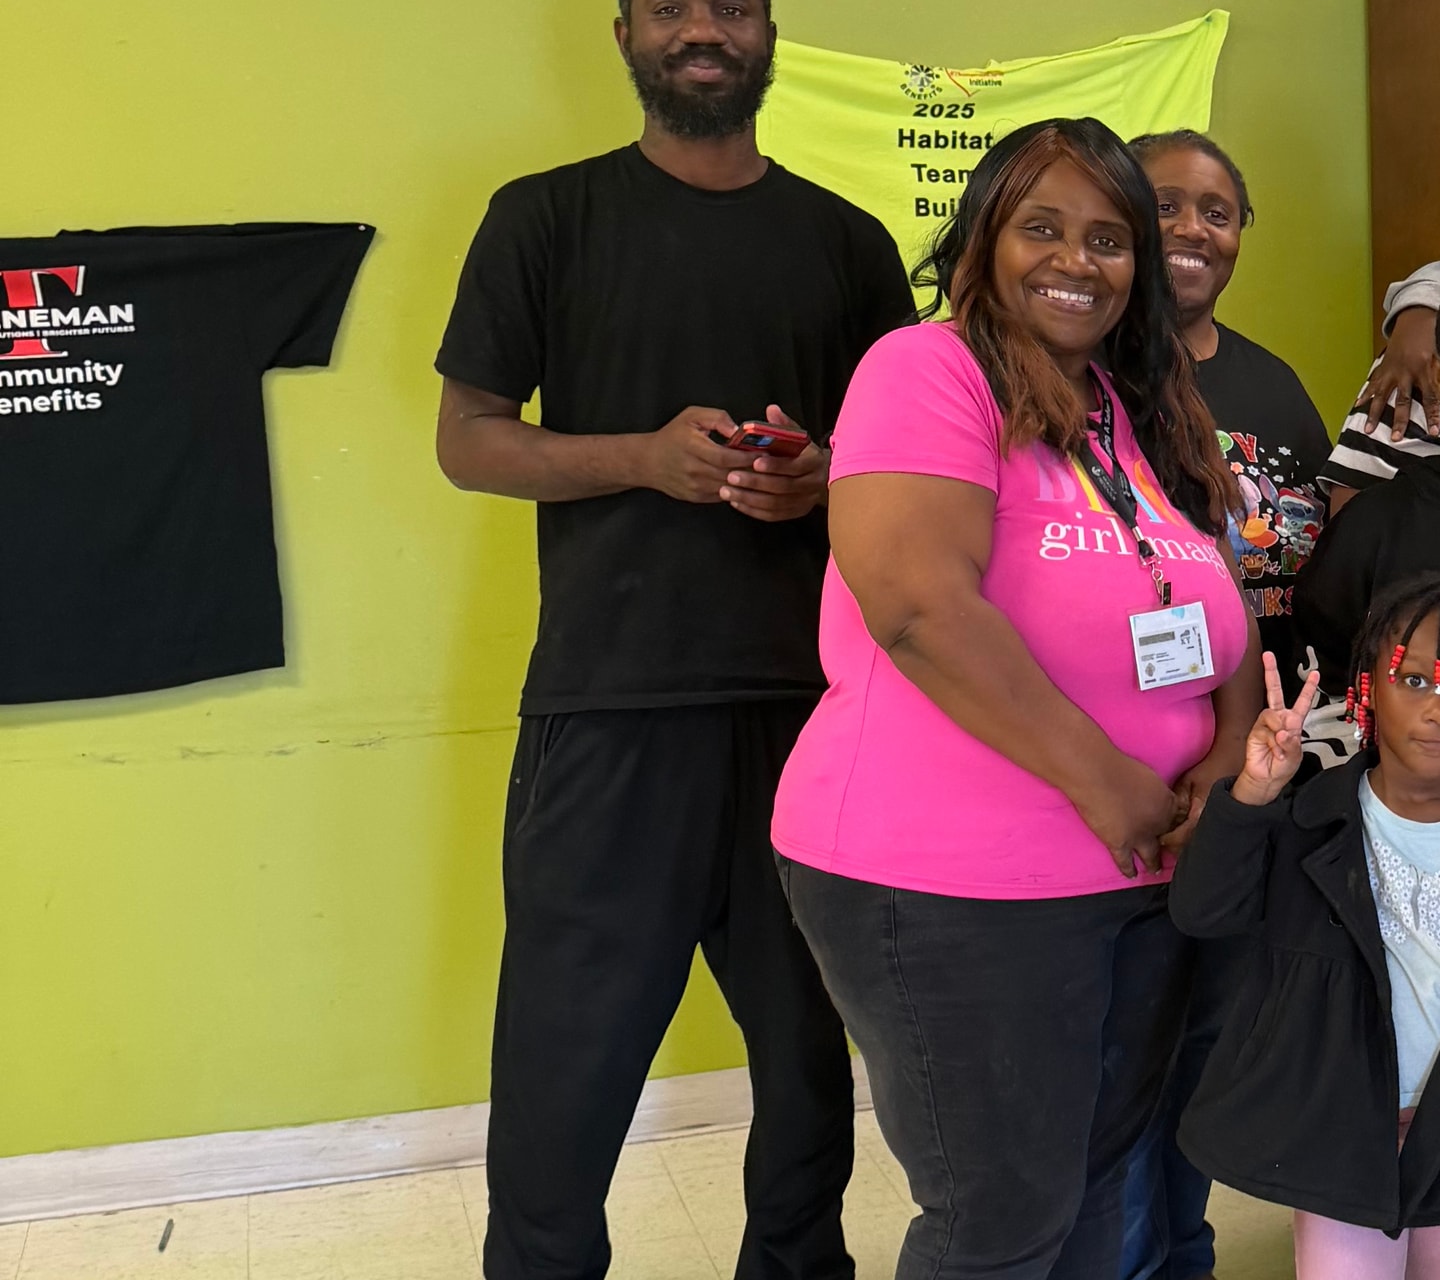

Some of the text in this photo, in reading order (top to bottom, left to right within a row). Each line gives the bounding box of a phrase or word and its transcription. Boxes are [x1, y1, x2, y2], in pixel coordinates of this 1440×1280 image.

[900, 83, 943, 100] BENEFITS
[913, 102, 975, 119] 2025
[898, 128, 993, 149] Habitat
[915, 197, 958, 217] Bui
[0, 303, 134, 329] NEMAN
[92, 325, 136, 334] FUTURES
[1039, 512, 1133, 561] girl
[1142, 536, 1228, 579] mag
